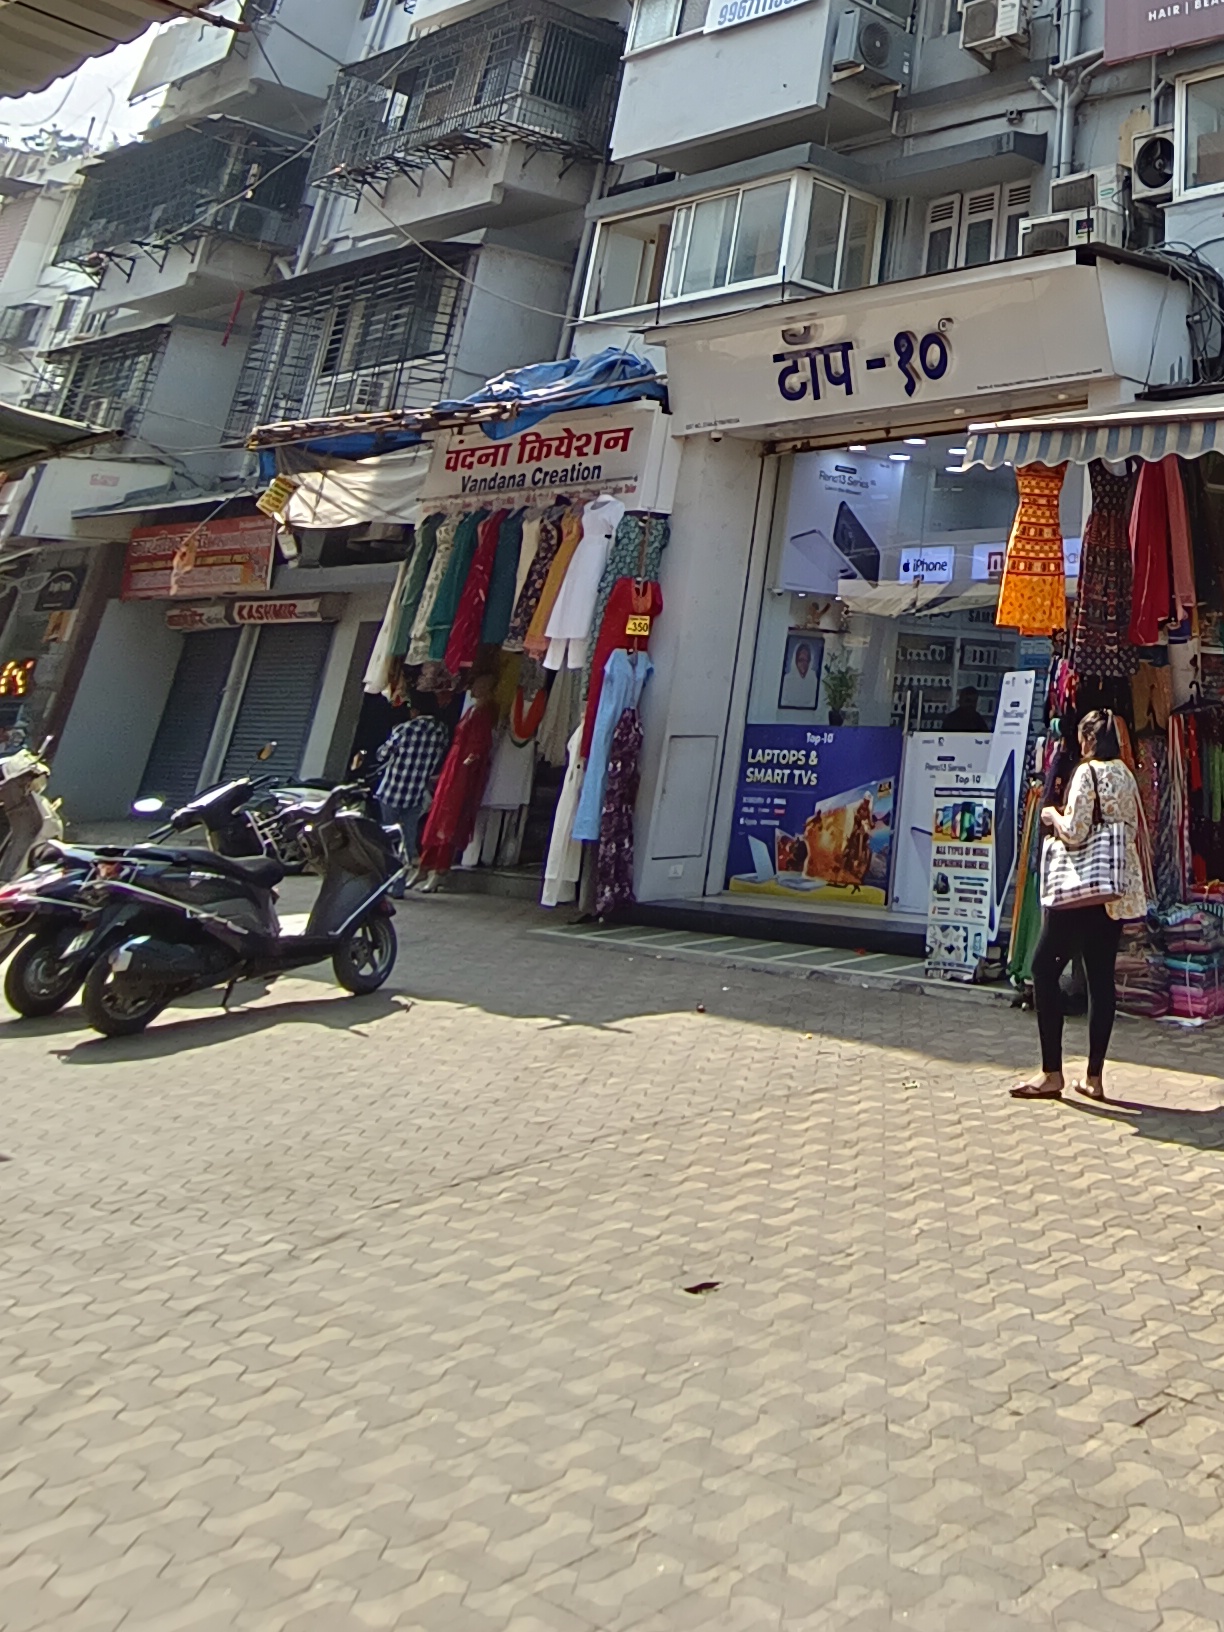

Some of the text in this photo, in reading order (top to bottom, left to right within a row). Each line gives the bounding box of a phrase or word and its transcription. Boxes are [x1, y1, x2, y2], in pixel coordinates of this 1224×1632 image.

[1147, 4, 1181, 22] HAIR
[445, 427, 634, 472] वंदना क्रियेशन
[461, 461, 602, 493] Vandana Creation
[913, 558, 948, 573] iPhone
[236, 602, 298, 621] KASHMIR
[632, 621, 649, 633] 350
[747, 748, 819, 766] LAPTOPS &
[745, 767, 818, 786] SMART TVs
[955, 774, 981, 785] Top 10
